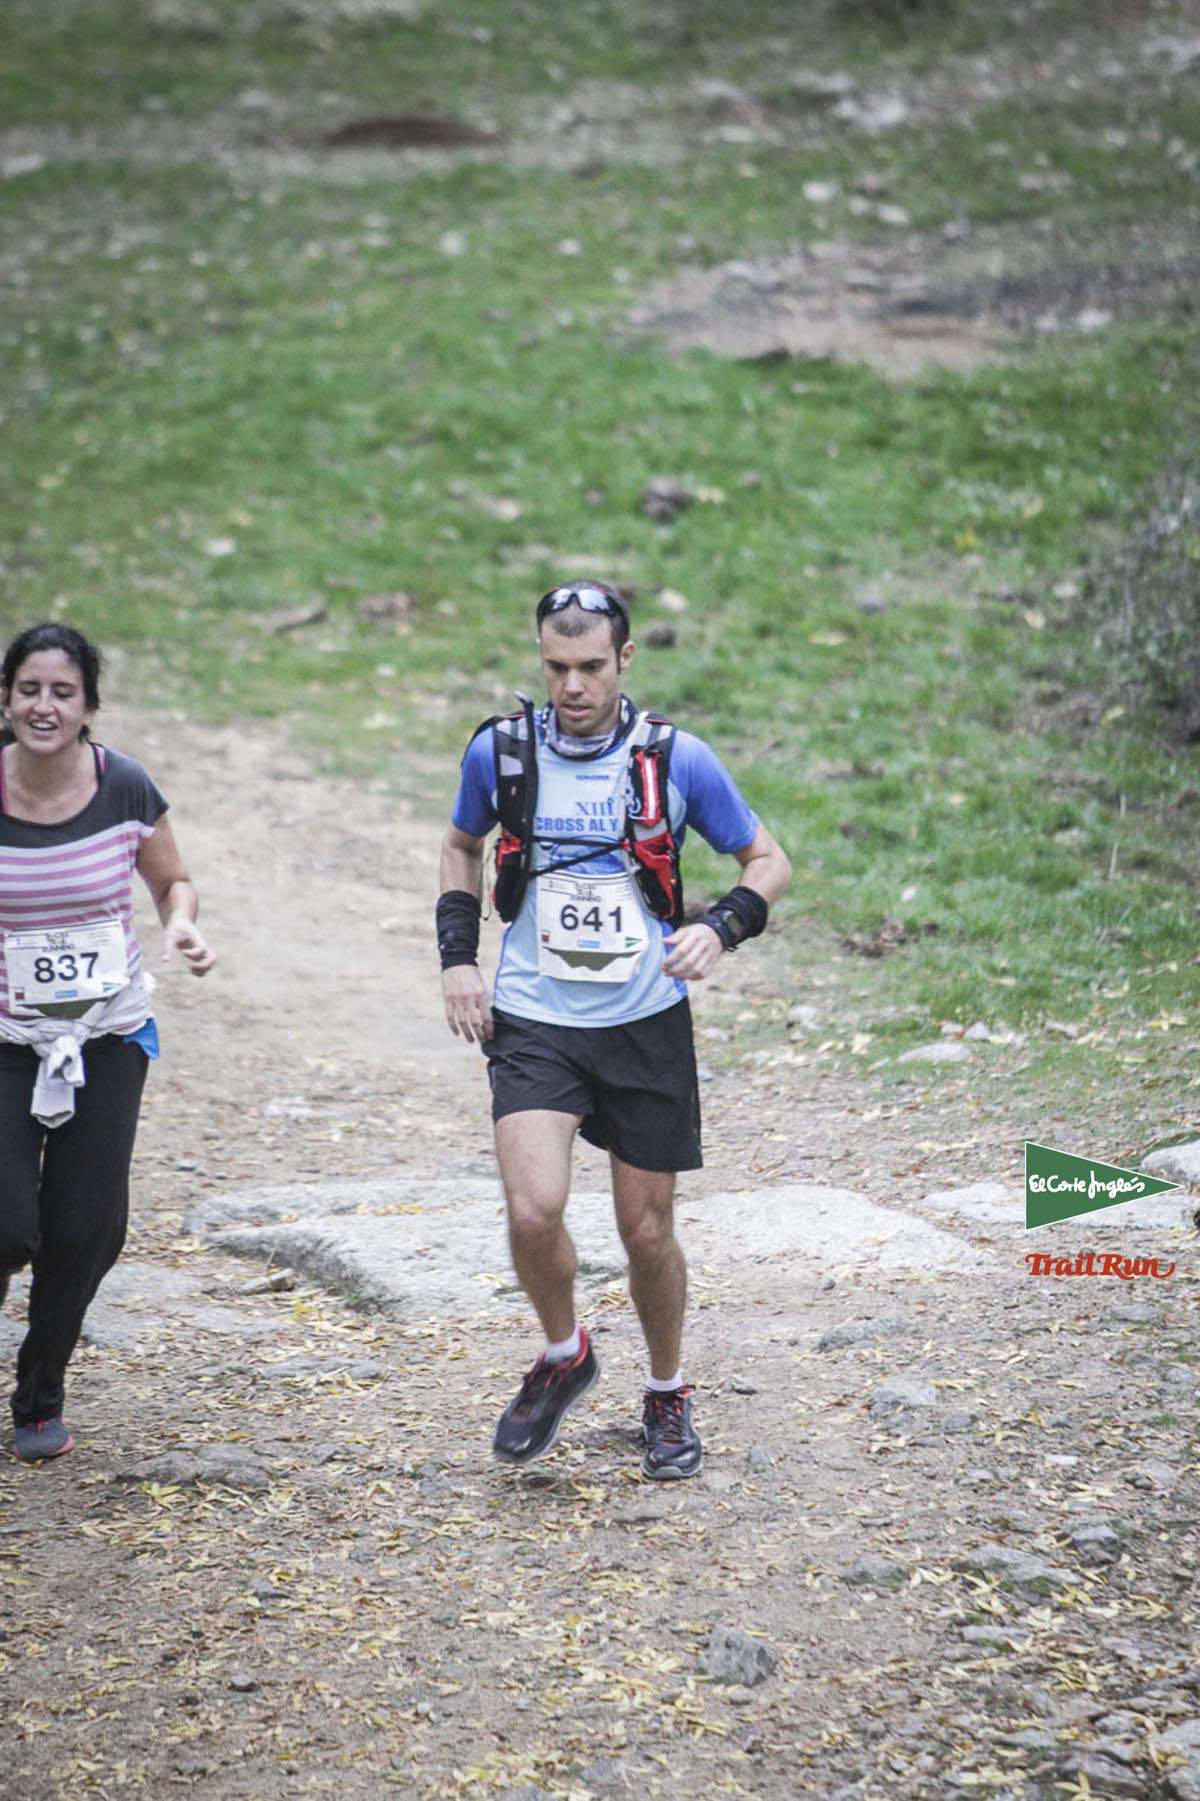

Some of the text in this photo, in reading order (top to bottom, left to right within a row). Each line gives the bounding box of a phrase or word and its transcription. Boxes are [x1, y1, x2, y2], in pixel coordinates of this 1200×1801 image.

[535, 816, 585, 832] CROSS
[560, 903, 622, 933] 641
[34, 952, 99, 984] 837
